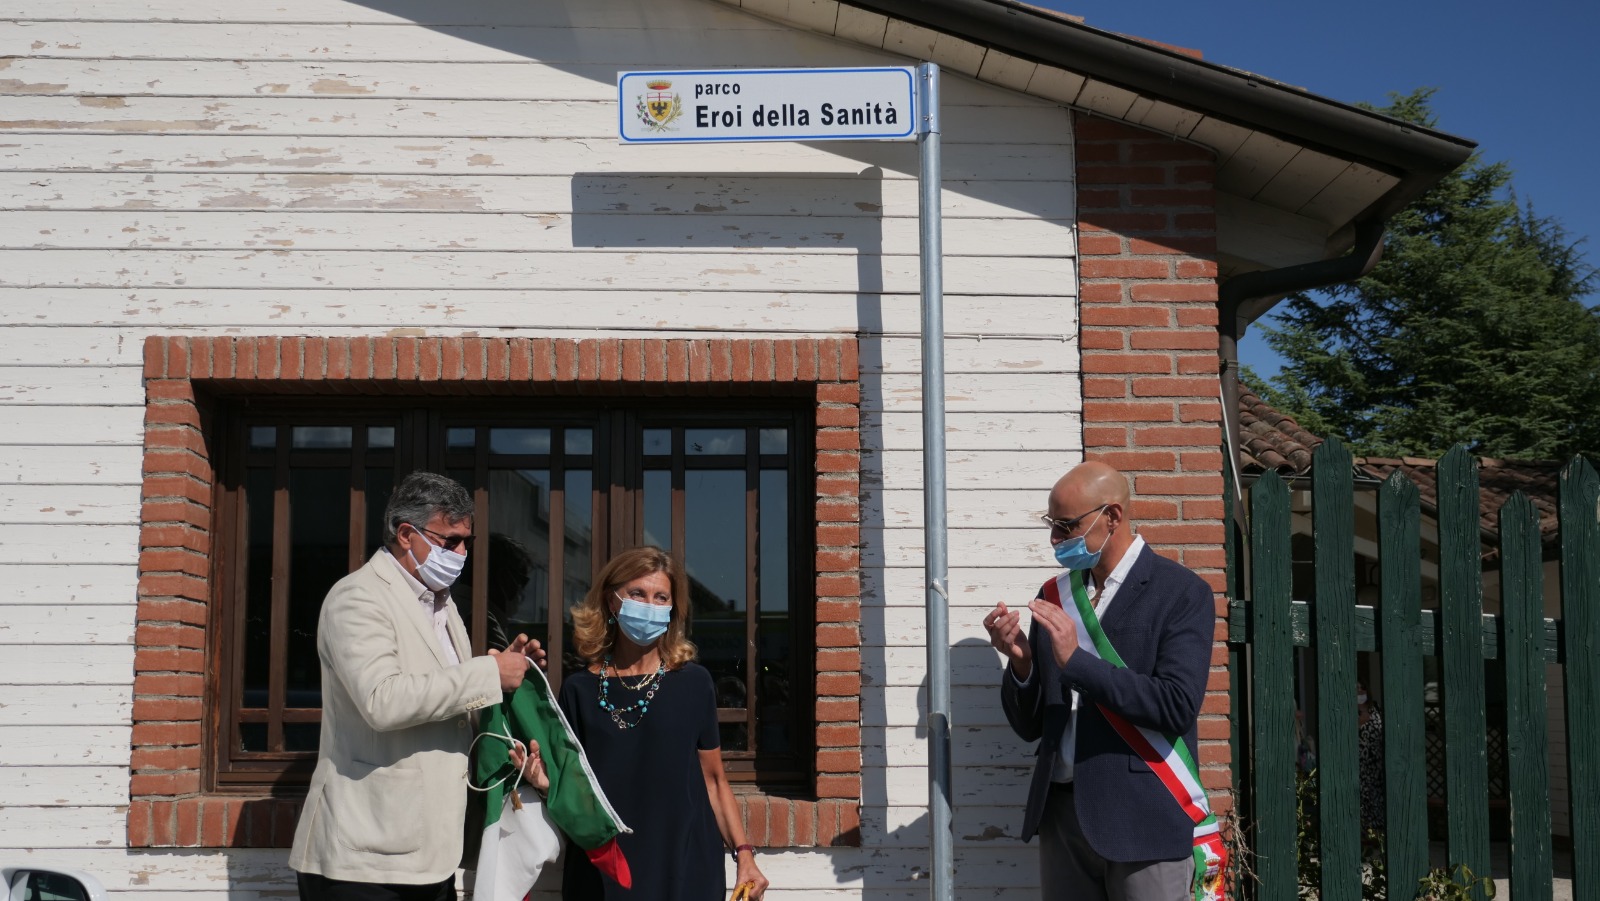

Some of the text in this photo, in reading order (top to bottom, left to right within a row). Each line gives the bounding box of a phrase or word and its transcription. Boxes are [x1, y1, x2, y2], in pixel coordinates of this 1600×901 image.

[695, 83, 741, 99] parco
[695, 101, 898, 127] Eroi della Sanità
